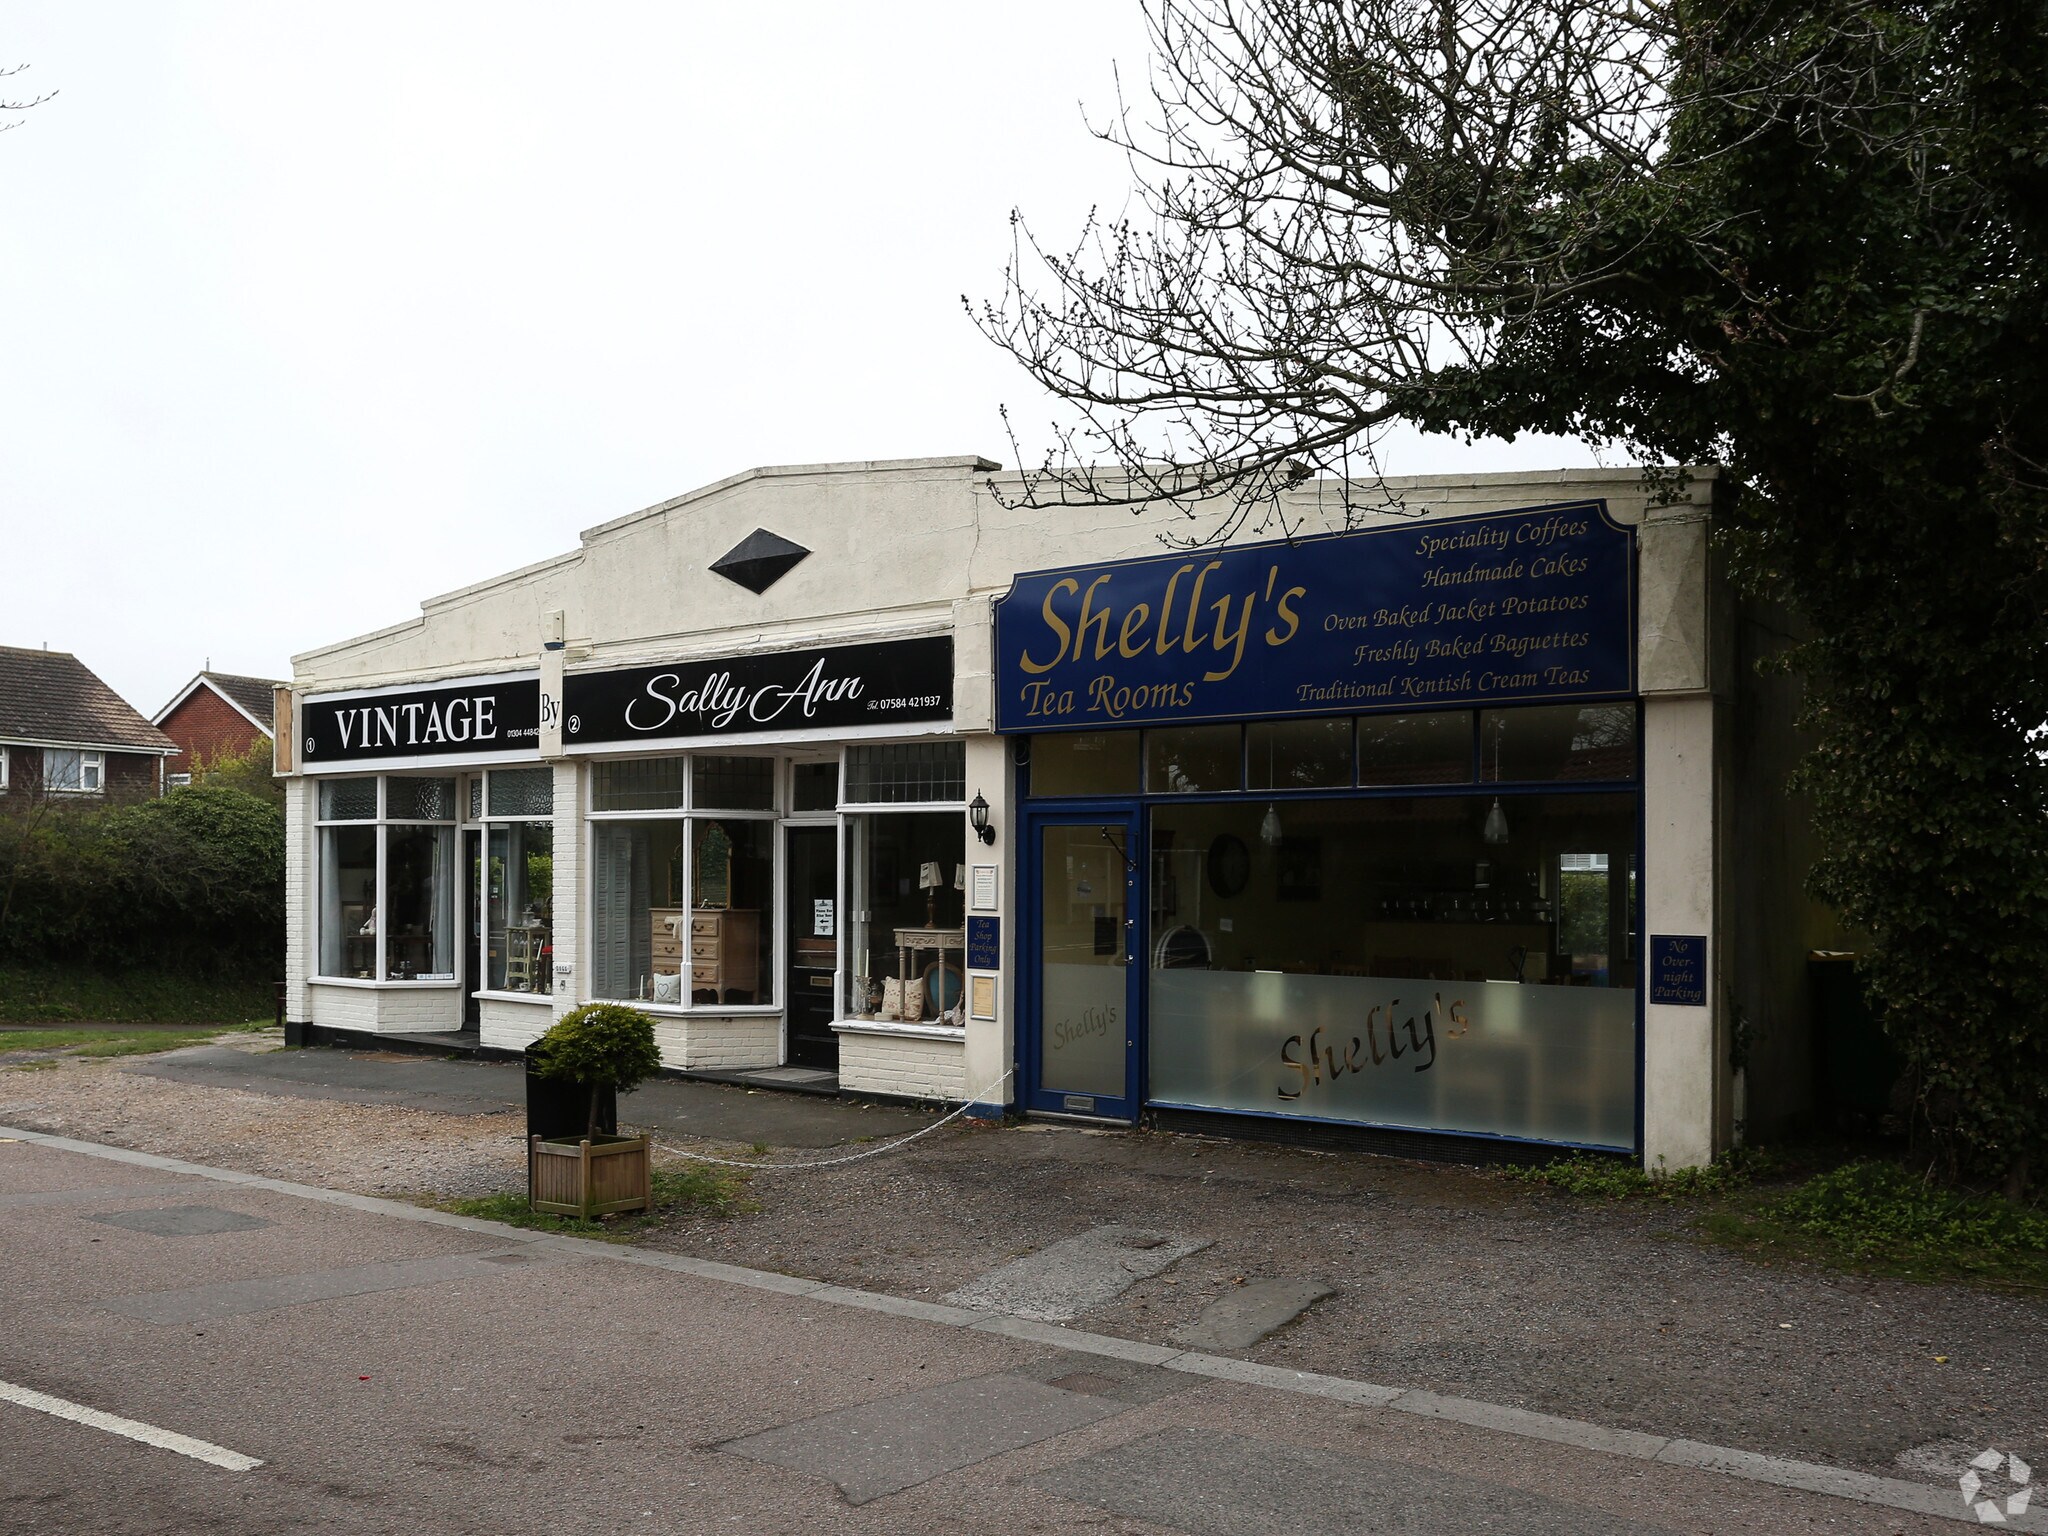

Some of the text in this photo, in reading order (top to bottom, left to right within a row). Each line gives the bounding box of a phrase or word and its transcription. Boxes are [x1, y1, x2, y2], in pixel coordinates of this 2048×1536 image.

[1415, 516, 1588, 559] Speciality Coffees
[1421, 552, 1588, 588] Handmade Cakes
[1019, 560, 1307, 682] Shelly's
[1324, 593, 1589, 632] Oven Baked Jacket Potatoes
[1353, 631, 1590, 666] Freshly Baked Baguettes
[624, 657, 865, 730] Sally Ann
[1021, 675, 1195, 719] Tea Rooms
[1296, 666, 1590, 702] Traditional Kentish Cream Teas
[541, 693, 560, 728] By
[880, 698, 906, 709] 07584
[908, 695, 941, 707] 421937
[334, 696, 498, 749] VINTAGE
[507, 729, 522, 738] 01304
[974, 930, 992, 943] Shop
[976, 919, 990, 928] Tea
[969, 942, 997, 954] Parking
[974, 954, 991, 966] Only
[1662, 956, 1694, 967] Over-
[1668, 939, 1688, 953] No
[1654, 985, 1702, 1002] Parking
[1663, 970, 1694, 985] night
[1053, 1004, 1117, 1050] Shelly's
[1277, 992, 1470, 1101] Shelly's
